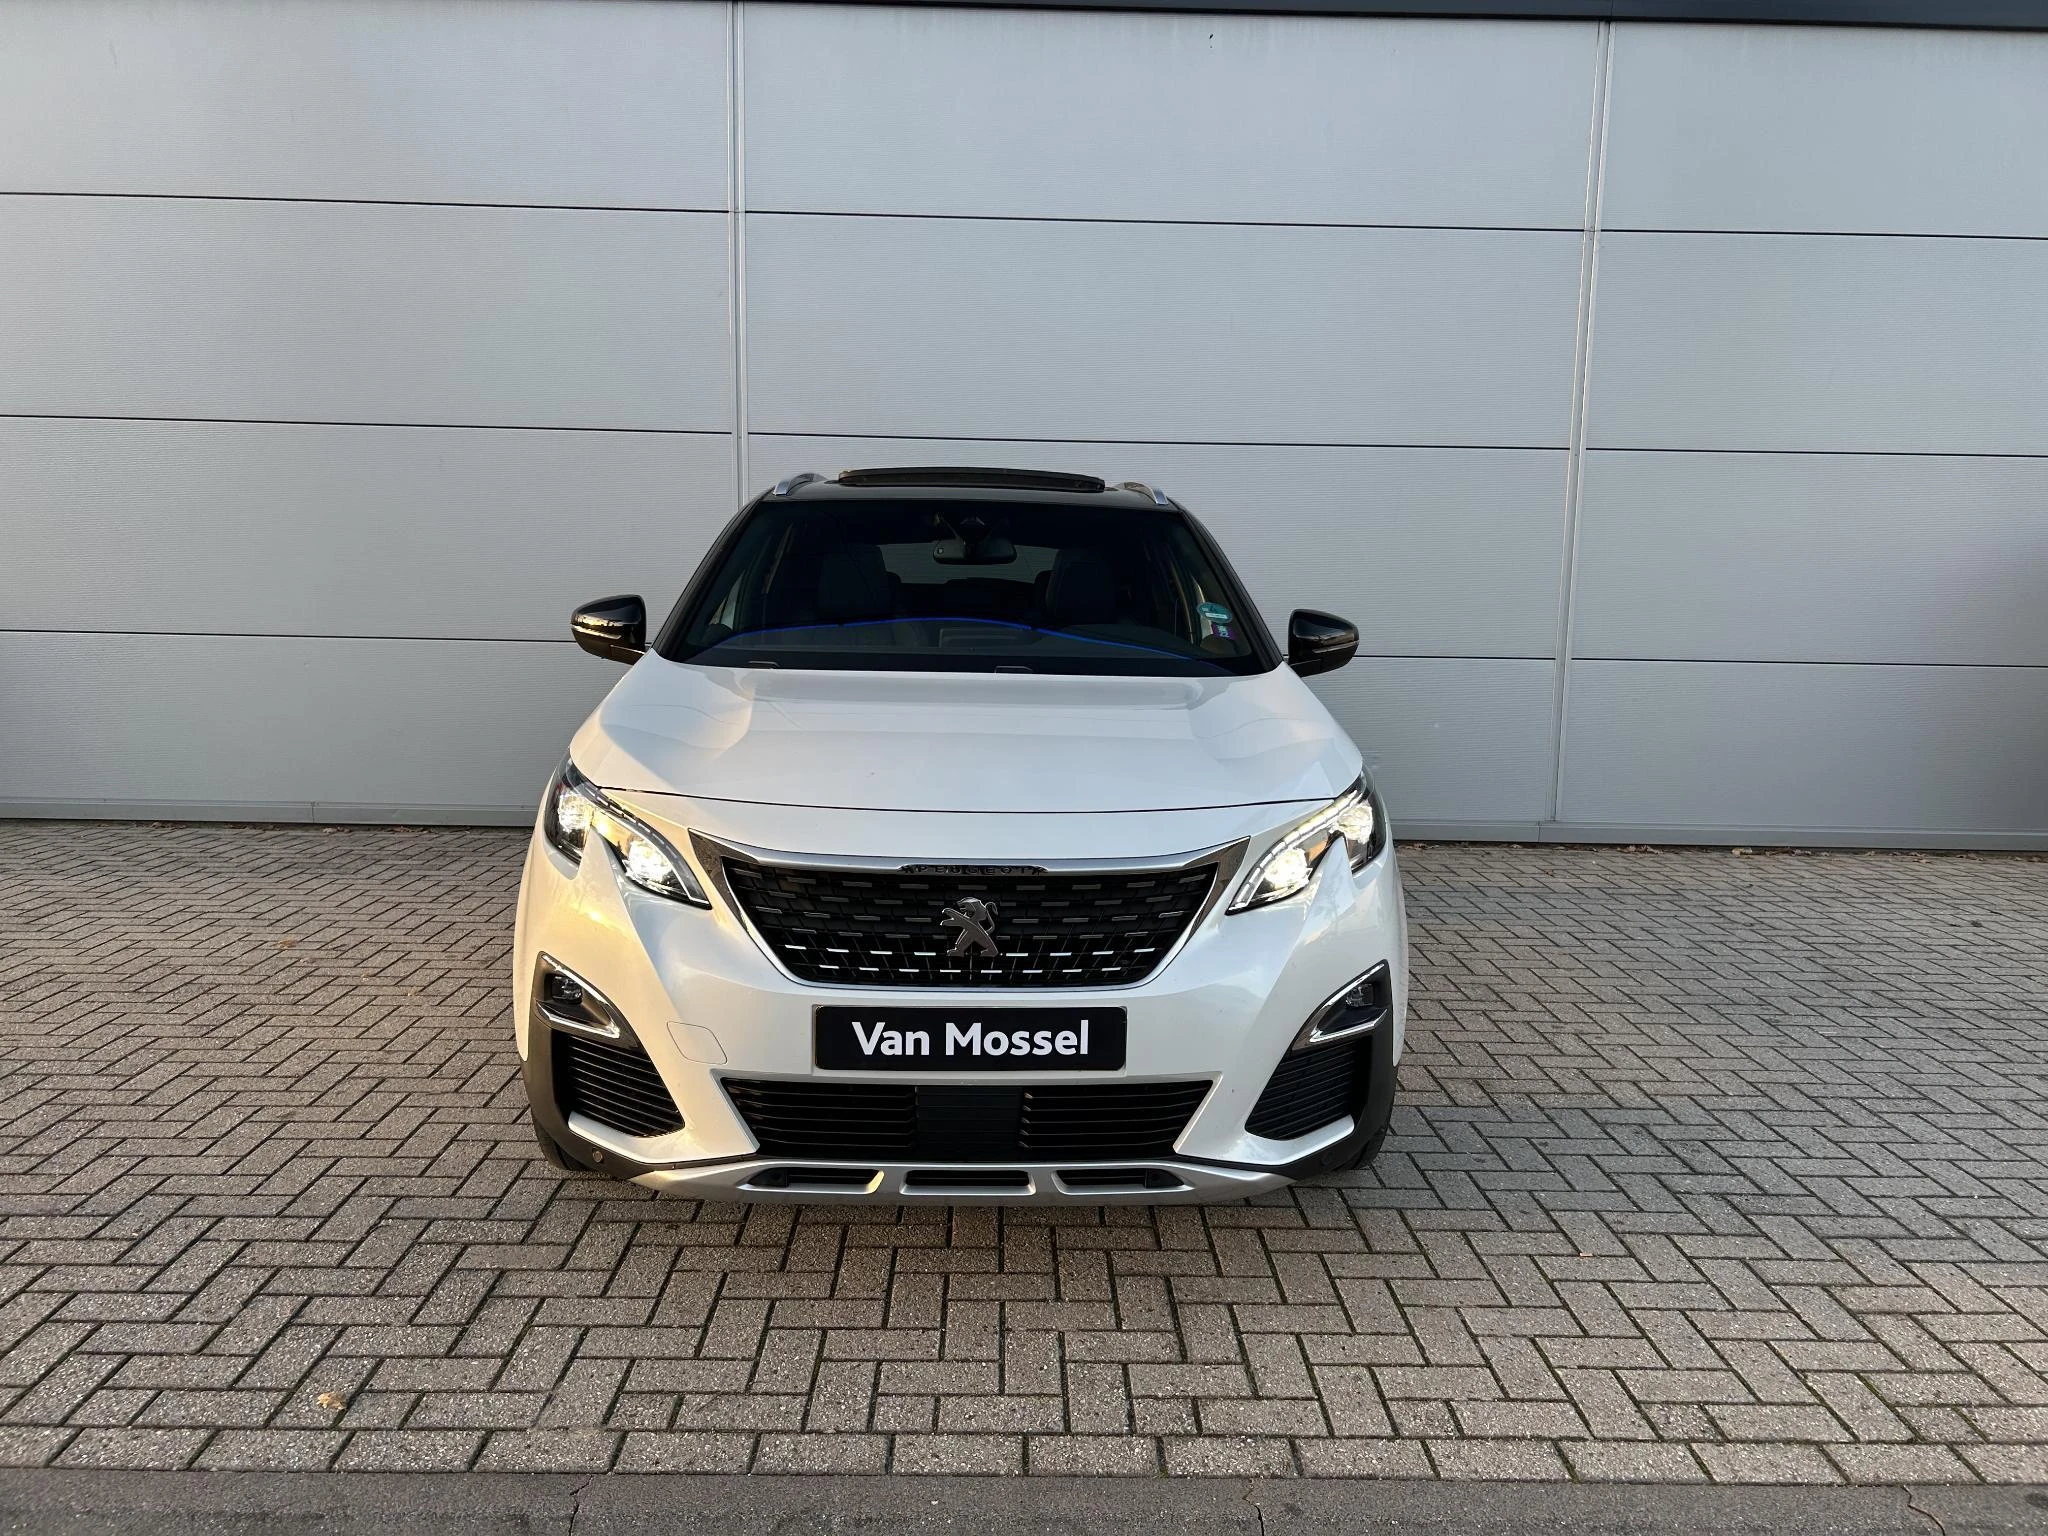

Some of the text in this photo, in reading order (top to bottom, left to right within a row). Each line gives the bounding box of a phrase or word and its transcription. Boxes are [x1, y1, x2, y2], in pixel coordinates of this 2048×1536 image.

[916, 865, 1029, 875] PEUGEOT
[852, 1019, 1089, 1056] Van Mossel
